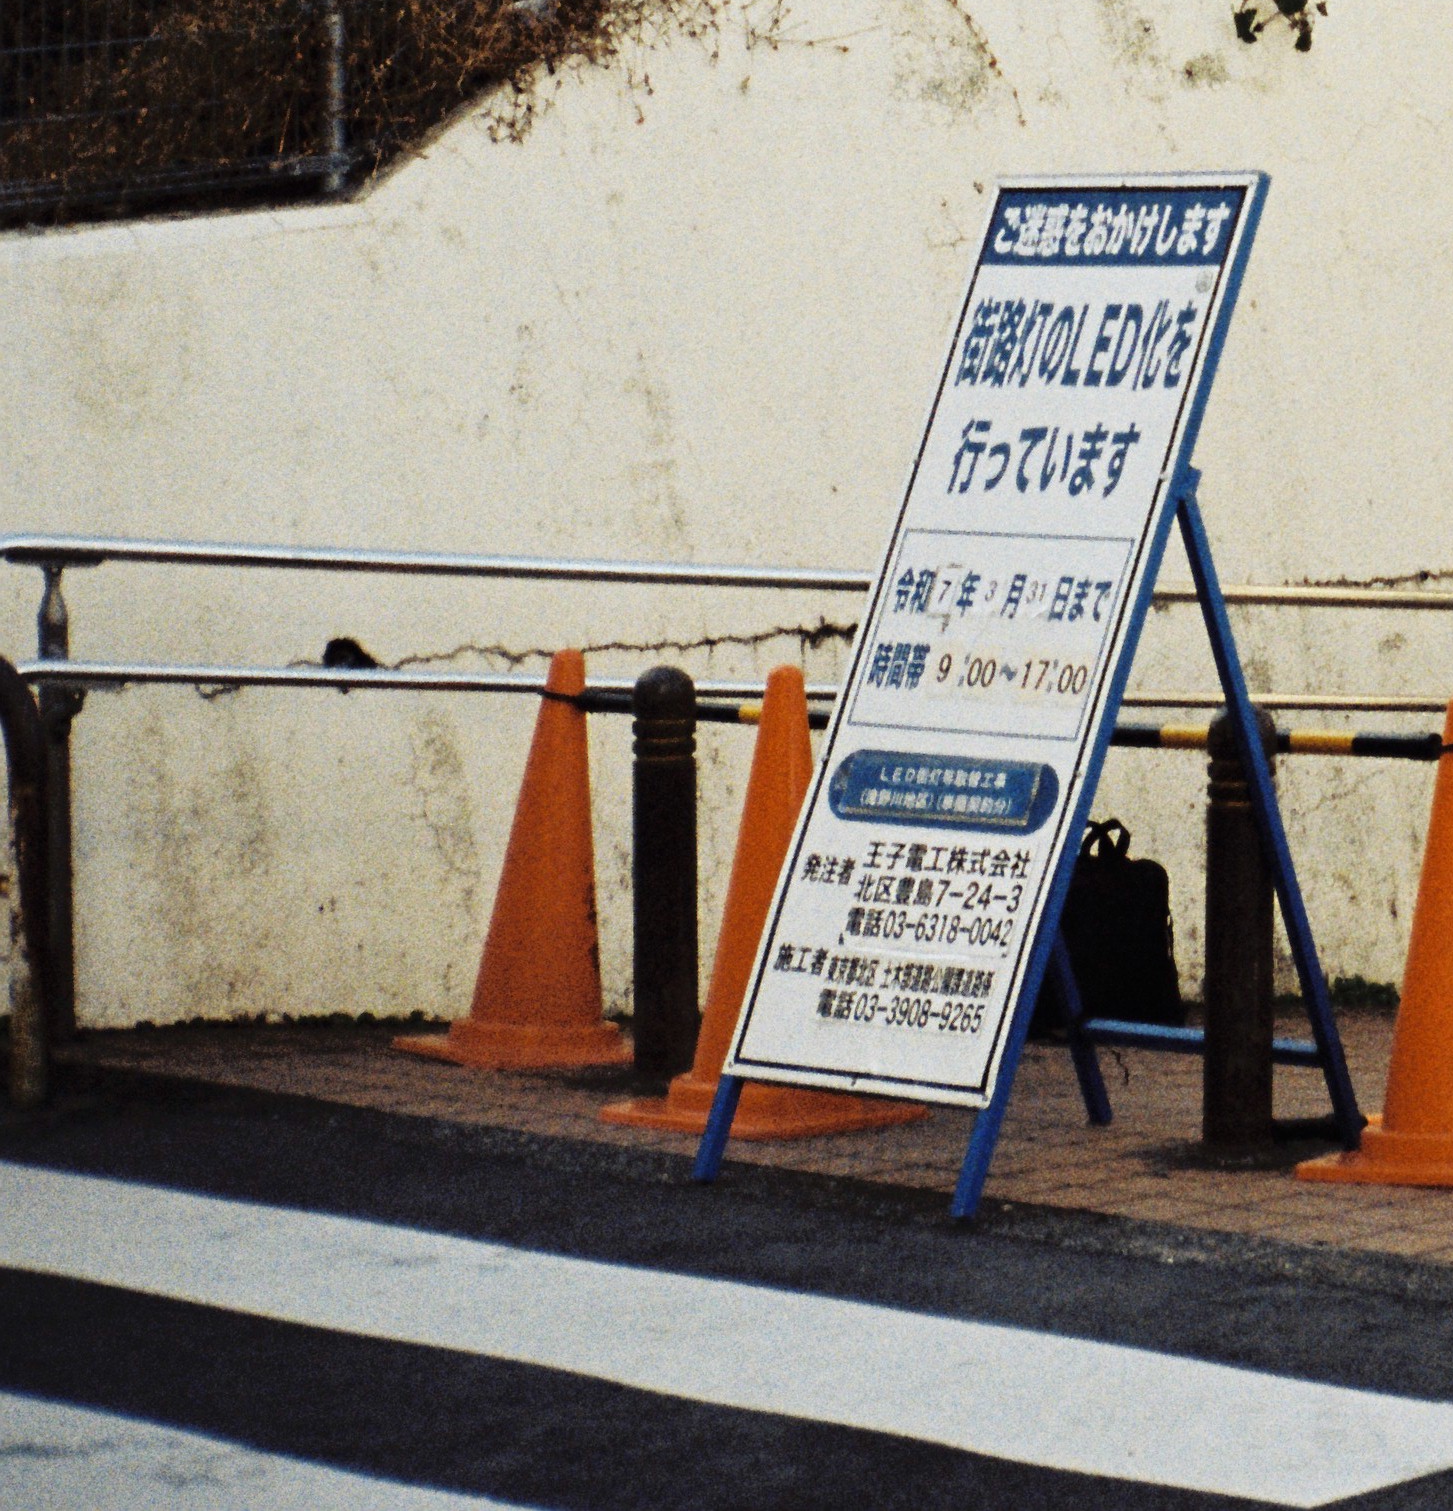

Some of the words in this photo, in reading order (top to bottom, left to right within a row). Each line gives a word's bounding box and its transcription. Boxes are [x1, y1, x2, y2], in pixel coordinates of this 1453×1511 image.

[991, 202, 1232, 257] ご迷惑をおかけします
[953, 298, 1198, 390] 街路灯のLED化を
[946, 418, 1140, 498] 行っています
[865, 642, 931, 691] 時間帯
[801, 852, 856, 886] 発注者
[862, 840, 1032, 880] 王子電工株式会社
[772, 943, 829, 976] 施工者
